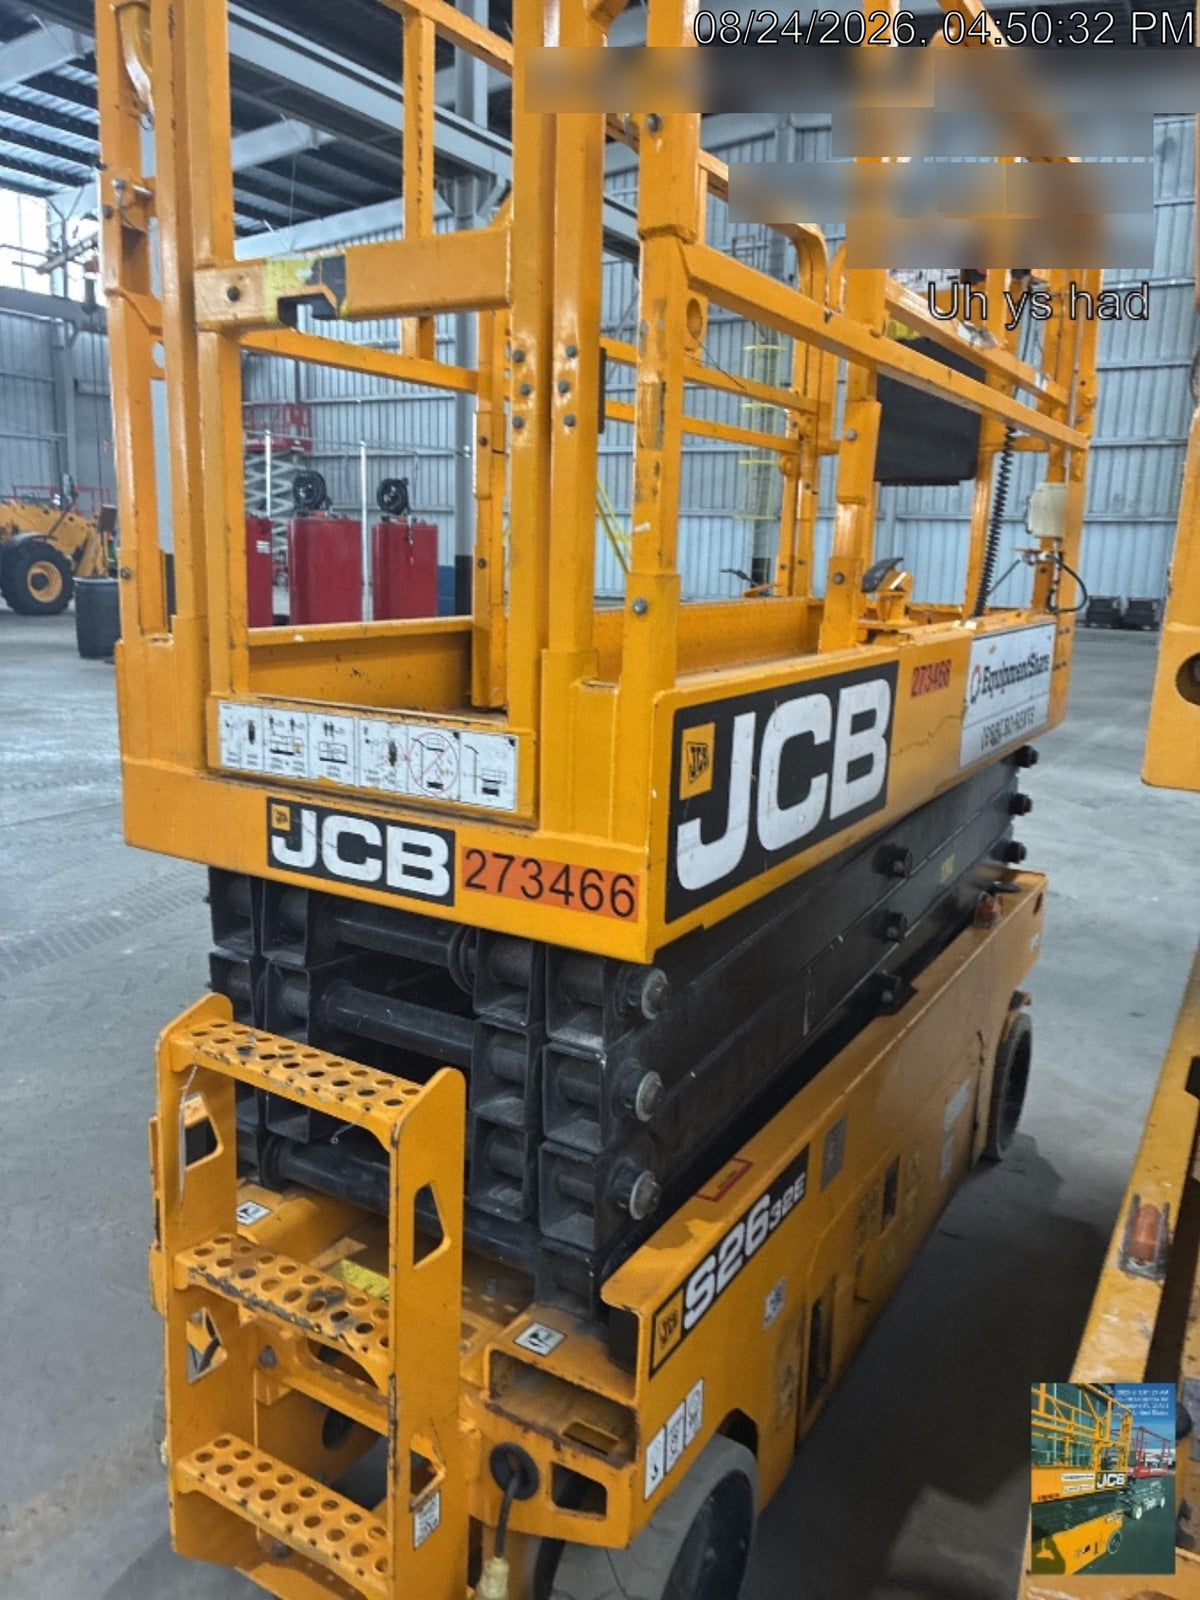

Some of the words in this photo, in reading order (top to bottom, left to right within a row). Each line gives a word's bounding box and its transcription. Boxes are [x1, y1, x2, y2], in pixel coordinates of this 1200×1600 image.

[677, 678, 891, 891] JCB
[272, 808, 451, 898] JCB
[464, 848, 636, 919] 273466
